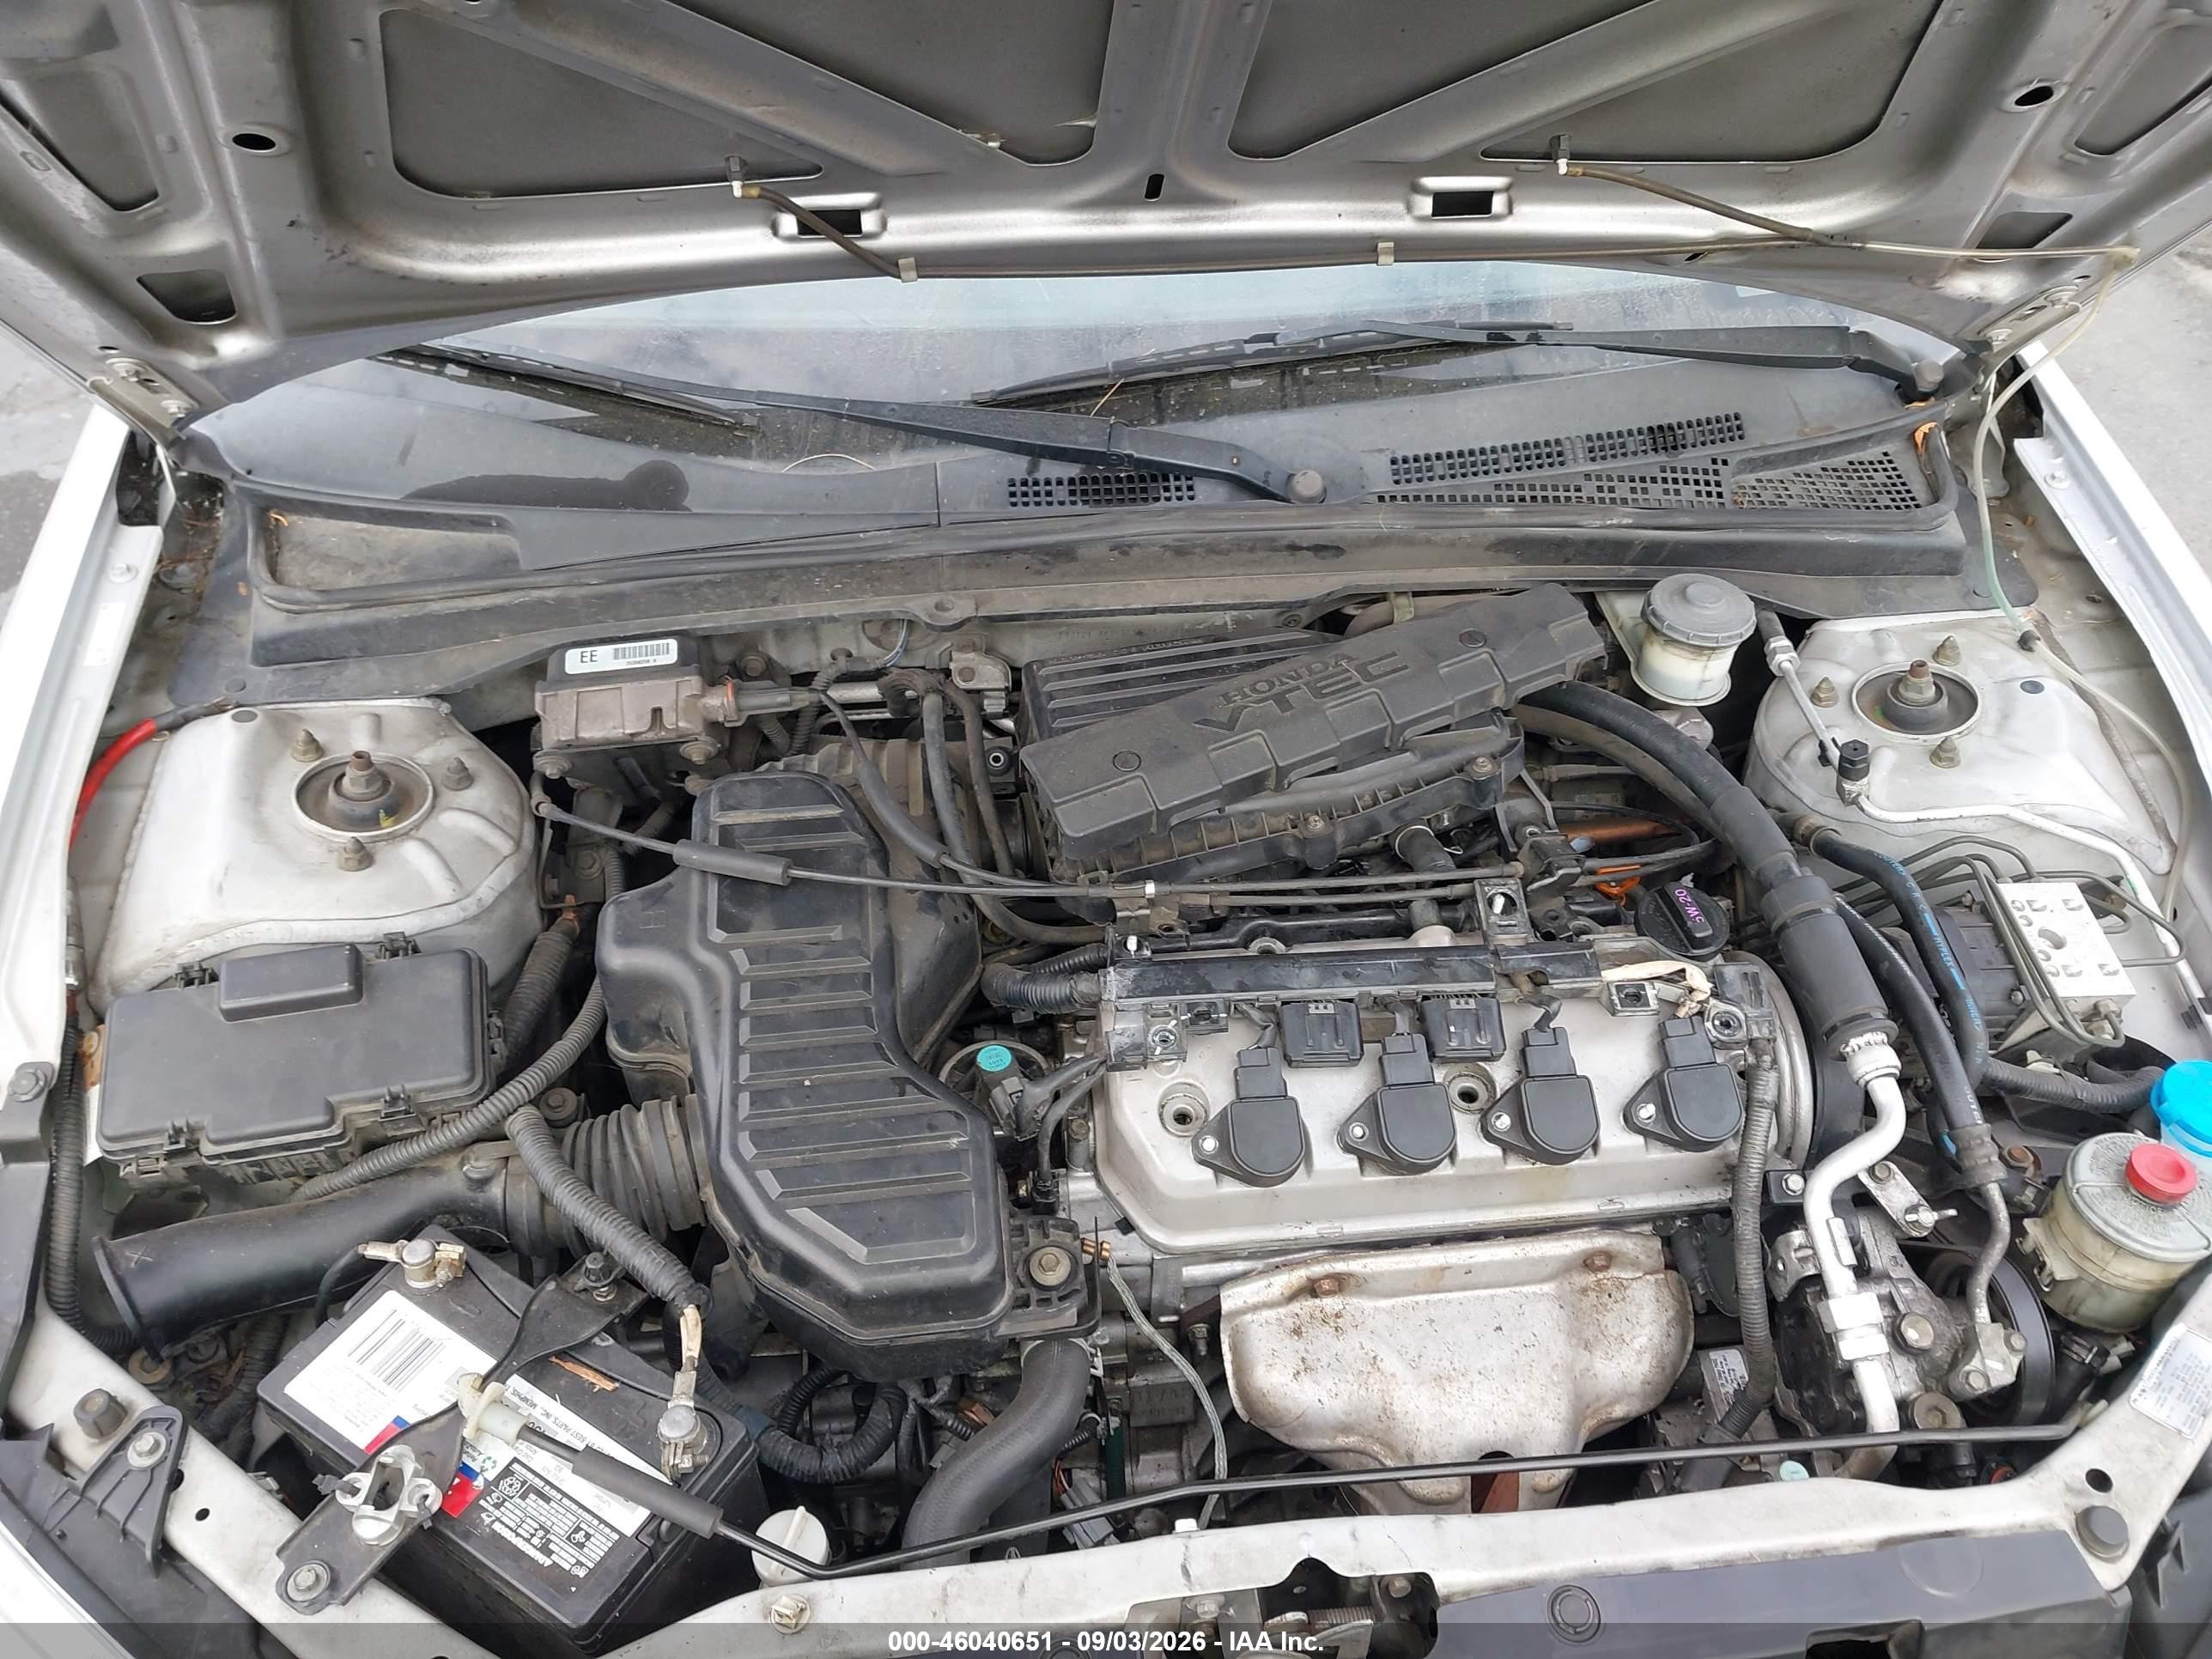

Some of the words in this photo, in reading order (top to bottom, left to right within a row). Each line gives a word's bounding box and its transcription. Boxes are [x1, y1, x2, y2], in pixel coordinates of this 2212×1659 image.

[580, 649, 599, 664] EE
[1193, 651, 1409, 732] VTEC
[1220, 652, 1358, 708] HONDA
[1674, 888, 1705, 924] 5W-20
[1933, 933, 1954, 969] HYPLEX
